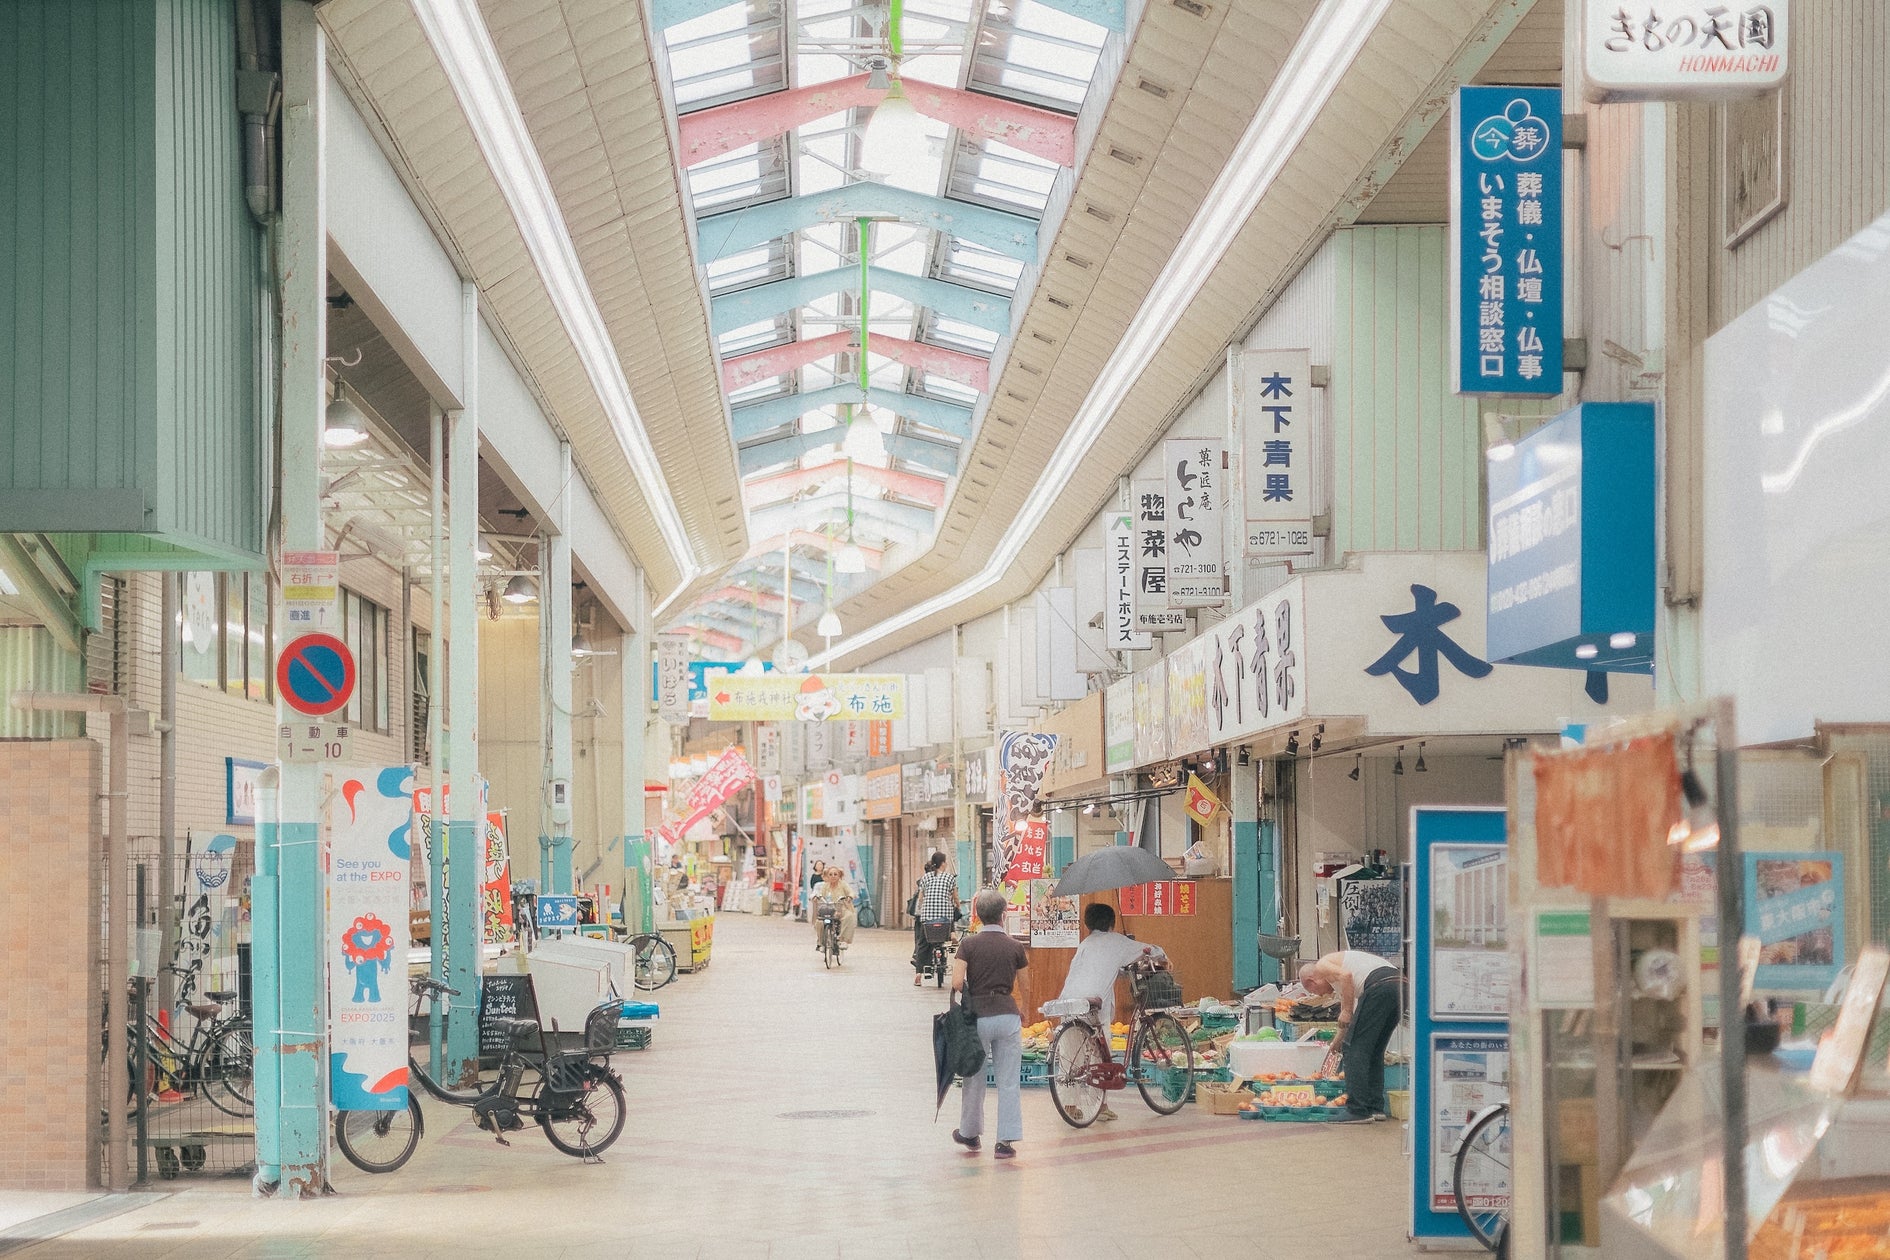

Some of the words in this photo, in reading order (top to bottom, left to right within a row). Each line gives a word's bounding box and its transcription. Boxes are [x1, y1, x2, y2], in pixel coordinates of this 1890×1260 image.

[1604, 4, 1775, 52] きもの天国
[1678, 54, 1780, 73] HONMACHI
[1479, 172, 1505, 378] いまそう相談窓口
[1516, 172, 1543, 380] 葬儀・仏壇・仏事
[1260, 371, 1293, 503] 木下青果
[1198, 447, 1212, 512] 菓匠庵
[1173, 459, 1203, 558] とらや
[1141, 493, 1166, 595] 惣菜屋
[1259, 531, 1308, 546] 6721-1025
[290, 573, 313, 585] 右折
[1180, 563, 1217, 574] 721-3100
[1117, 536, 1132, 642] エステートボンズ
[1139, 613, 1183, 625] 布施壱号店
[1364, 583, 1494, 706] 木
[848, 693, 893, 714] 布施
[336, 858, 359, 868] See
[361, 861, 381, 870] you
[336, 872, 347, 882] at
[350, 872, 368, 882] the
[370, 871, 402, 882] EXPO
[341, 1013, 395, 1023] EXPO2025
